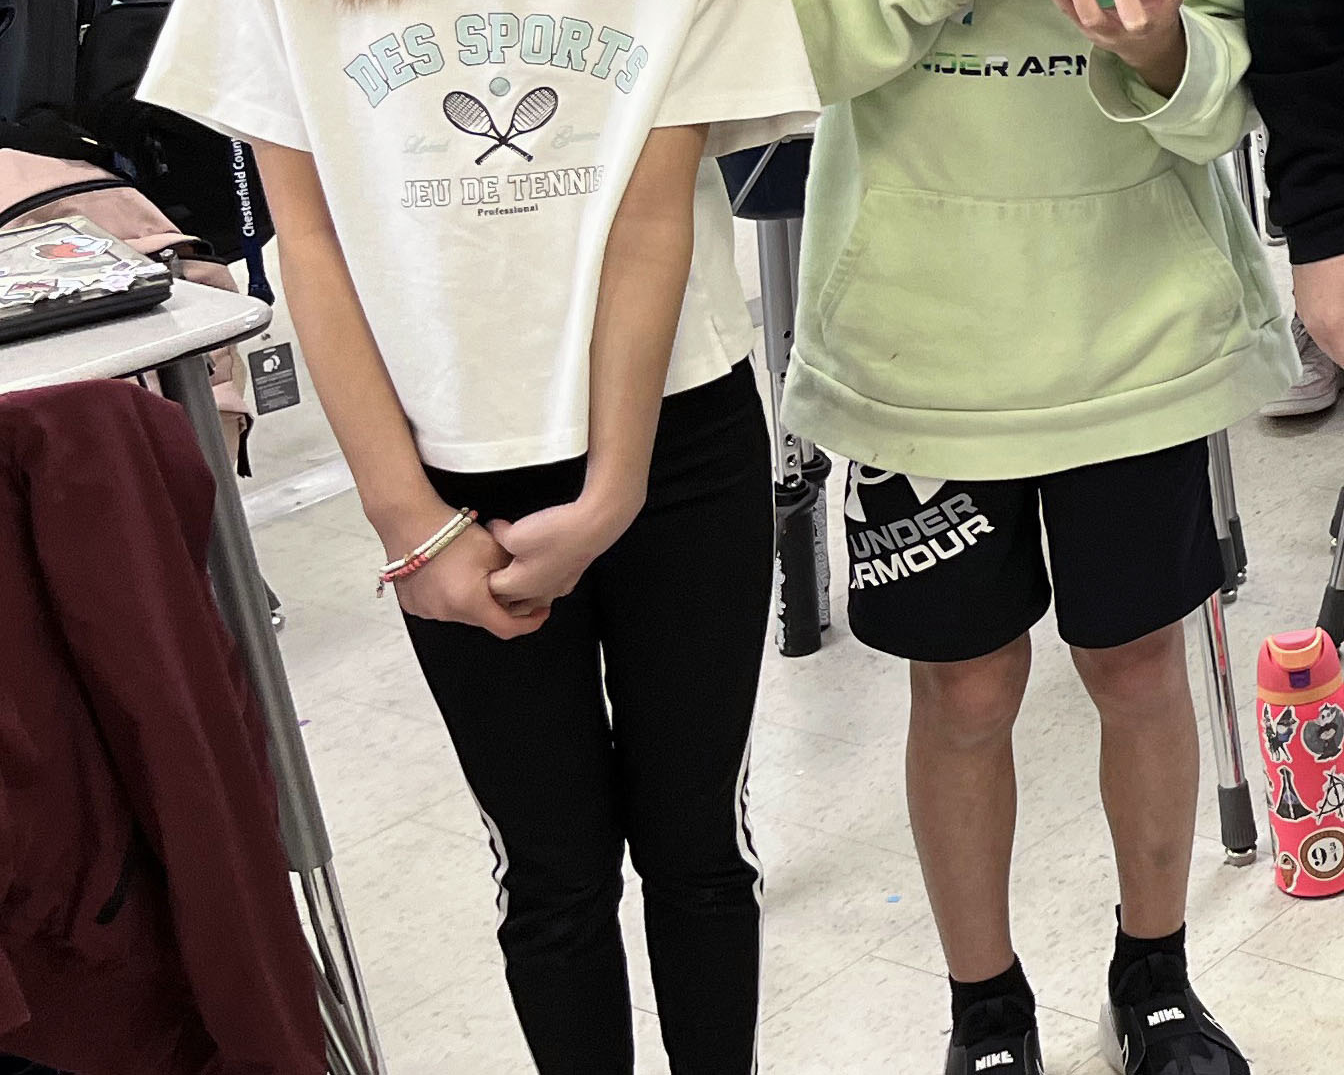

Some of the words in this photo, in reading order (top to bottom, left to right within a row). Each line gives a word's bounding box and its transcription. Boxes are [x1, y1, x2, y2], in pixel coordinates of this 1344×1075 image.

[343, 22, 445, 109] DES
[454, 11, 649, 95] SPORTS
[234, 170, 256, 238] Chesterfield
[400, 178, 452, 209] JEU
[461, 175, 501, 206] DE
[507, 164, 606, 202] TENNIS
[476, 203, 539, 218] Professional
[849, 492, 979, 559] UNDER
[1147, 1006, 1186, 1027] NIKE
[975, 1050, 1014, 1072] NIKE
